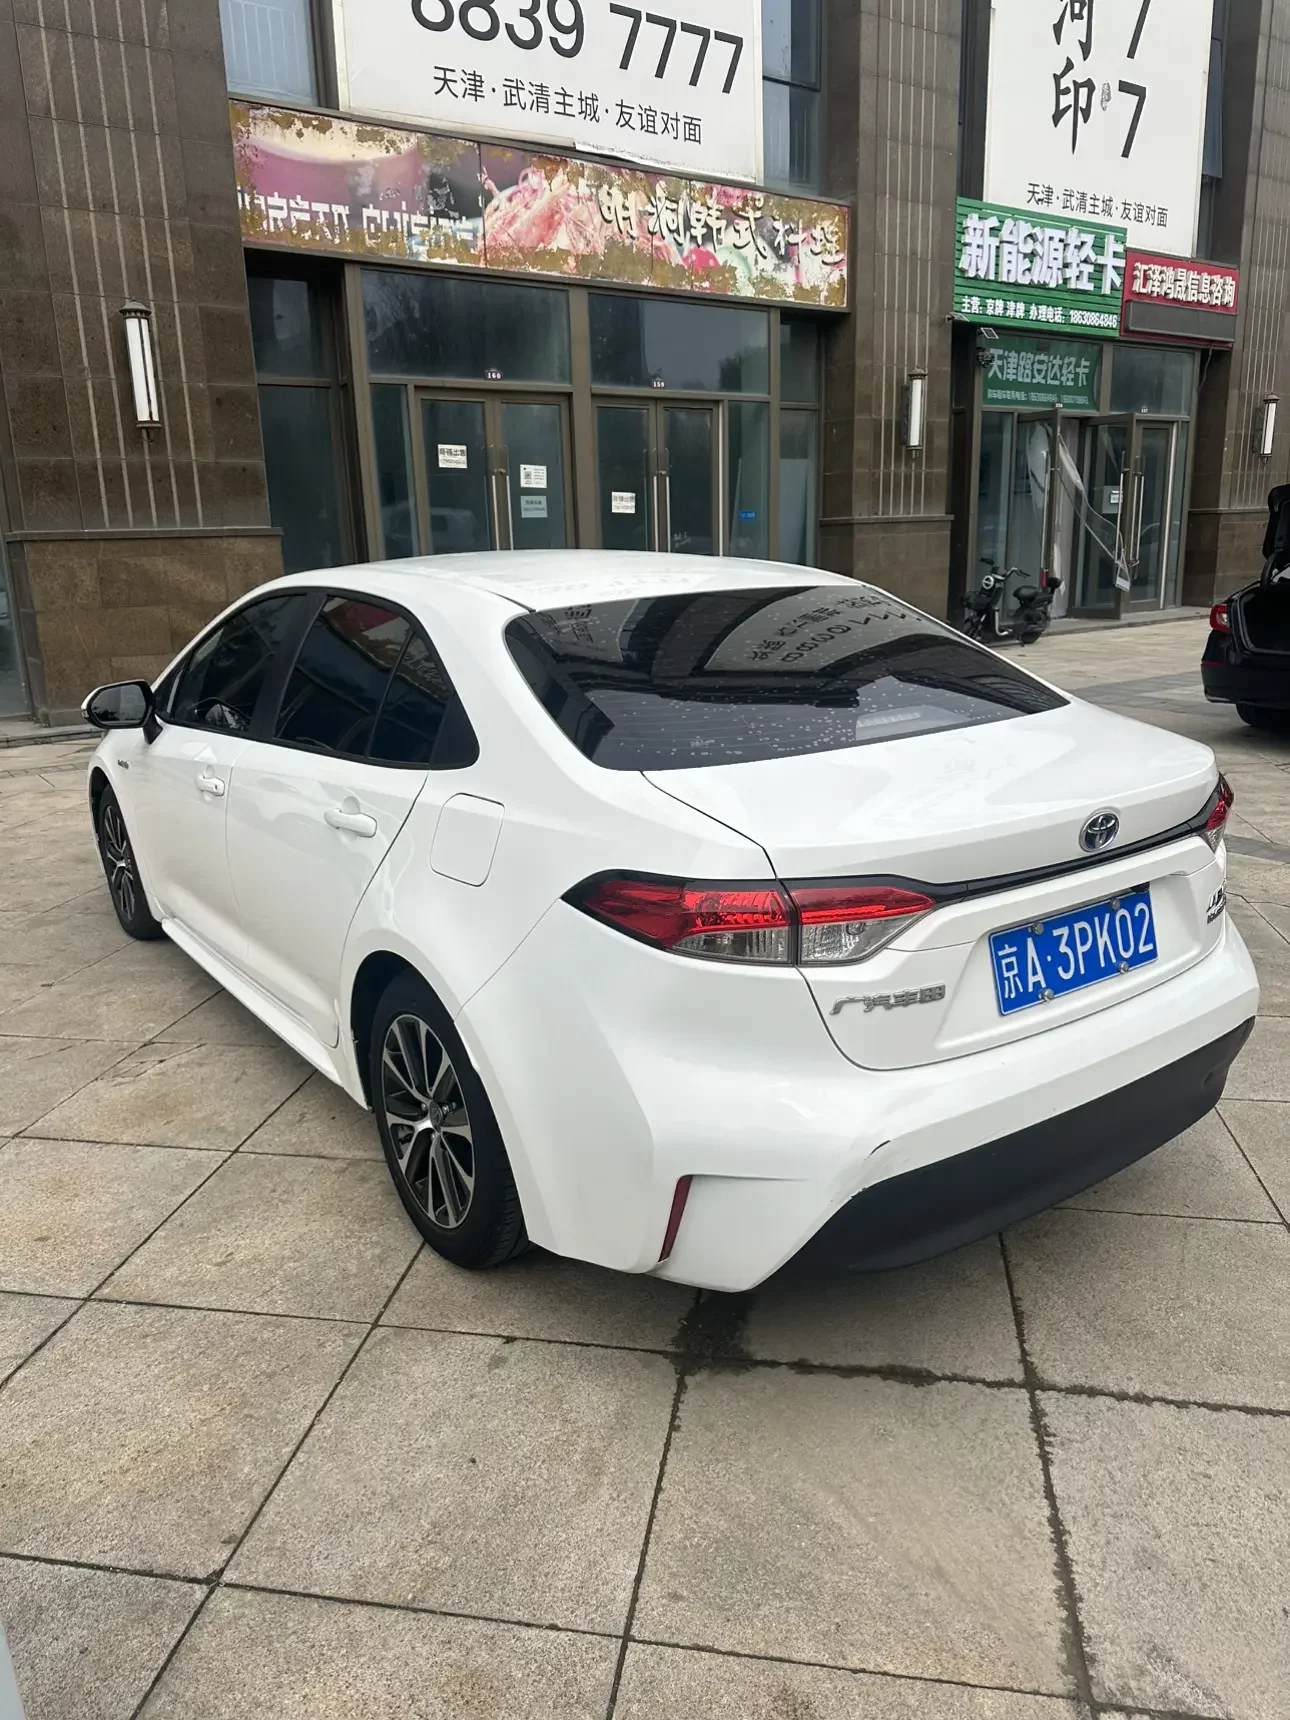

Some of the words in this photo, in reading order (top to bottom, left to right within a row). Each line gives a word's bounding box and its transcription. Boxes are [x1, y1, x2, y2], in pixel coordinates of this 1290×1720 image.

[609, 2, 744, 94] 7777
[432, 65, 703, 145] 天津·武清主城·友谊对面
[1026, 182, 1169, 228] 天津·武清主城·友谊对面
[958, 212, 1127, 295] 新能源轻卡
[1131, 261, 1236, 308] 汇泽鸿晟信息咨询
[985, 298, 1004, 317] 京牌
[1069, 309, 1119, 329] 18630864846
[987, 348, 1091, 387] 天津路安达轻卡
[997, 902, 1155, 999] 京A·3PK02
[828, 983, 947, 1016] 广汽丰田
